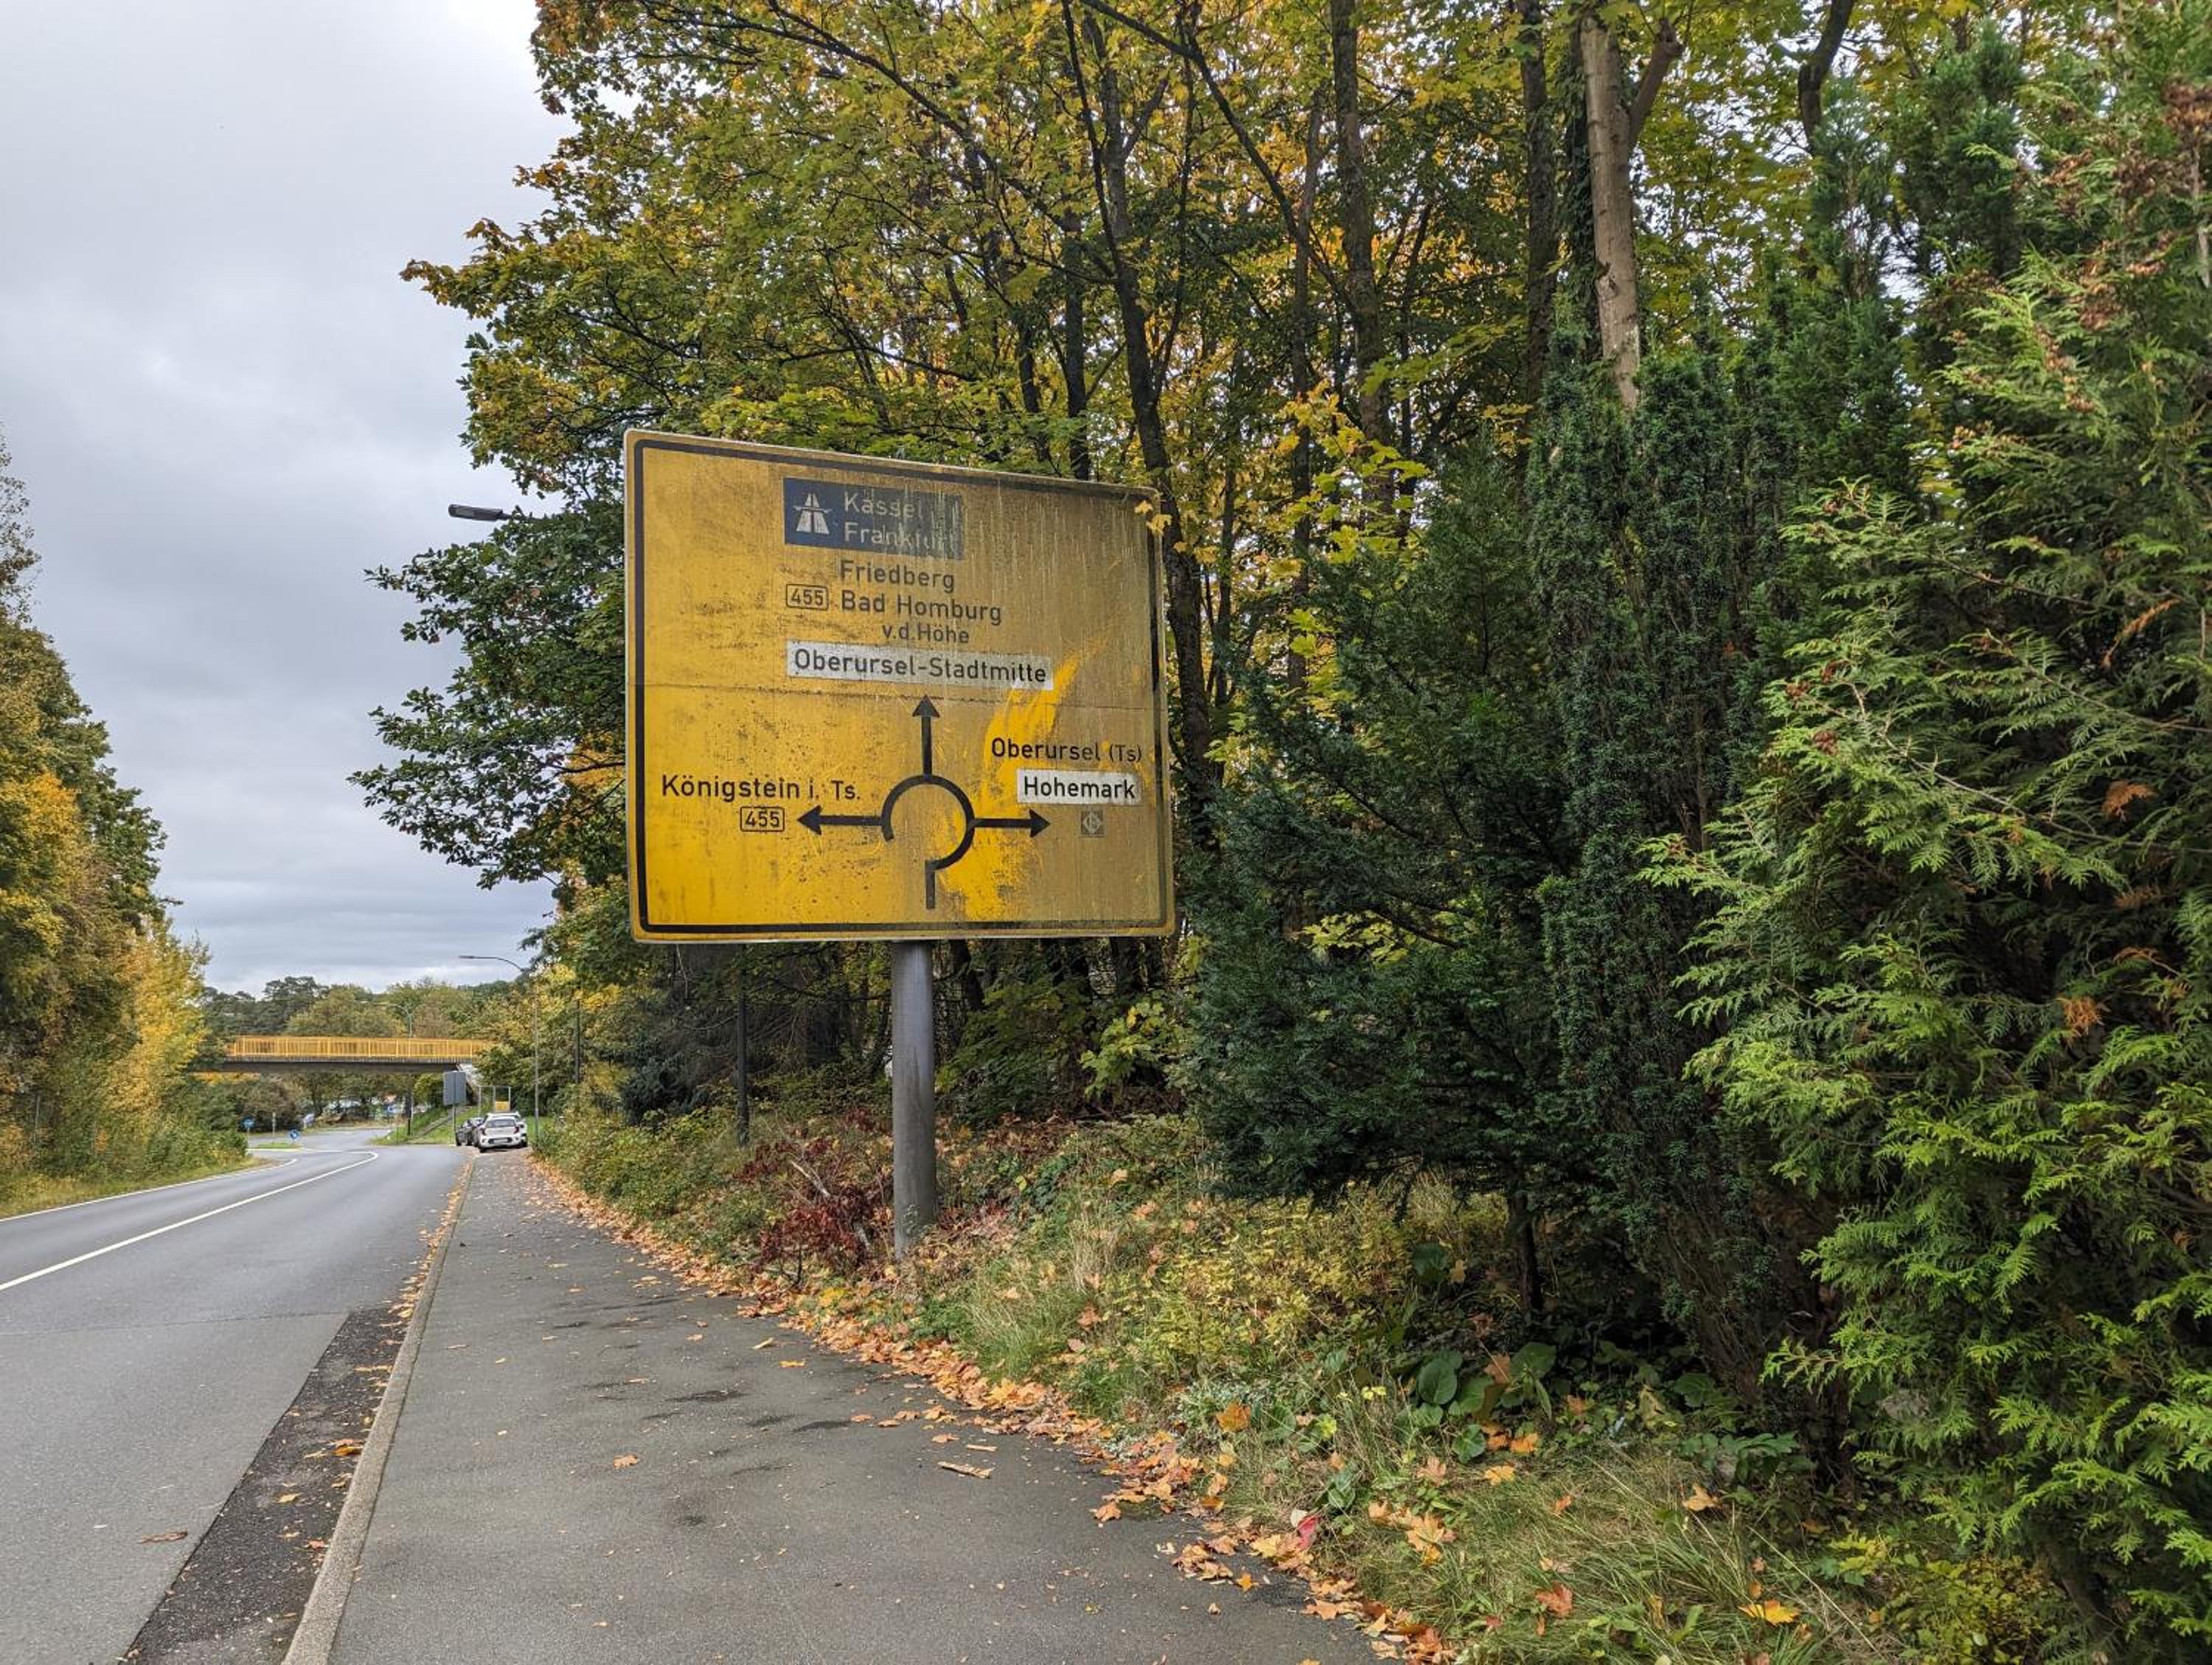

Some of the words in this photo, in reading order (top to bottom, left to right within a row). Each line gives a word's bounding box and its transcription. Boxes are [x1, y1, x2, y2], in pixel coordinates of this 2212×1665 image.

[840, 560, 955, 592] Friedberg
[791, 591, 824, 606] 455
[842, 591, 886, 613] Bad
[897, 595, 1001, 625] Homburg
[794, 649, 1046, 682] Oberursel-Stadtmitte
[992, 737, 1100, 761] Oberursel
[1109, 744, 1142, 762] (Ts)
[662, 775, 800, 802] Königstein
[810, 779, 819, 799] i.
[831, 780, 860, 801] Ts.
[1024, 776, 1135, 799] Hohemark
[745, 811, 779, 827] 455
